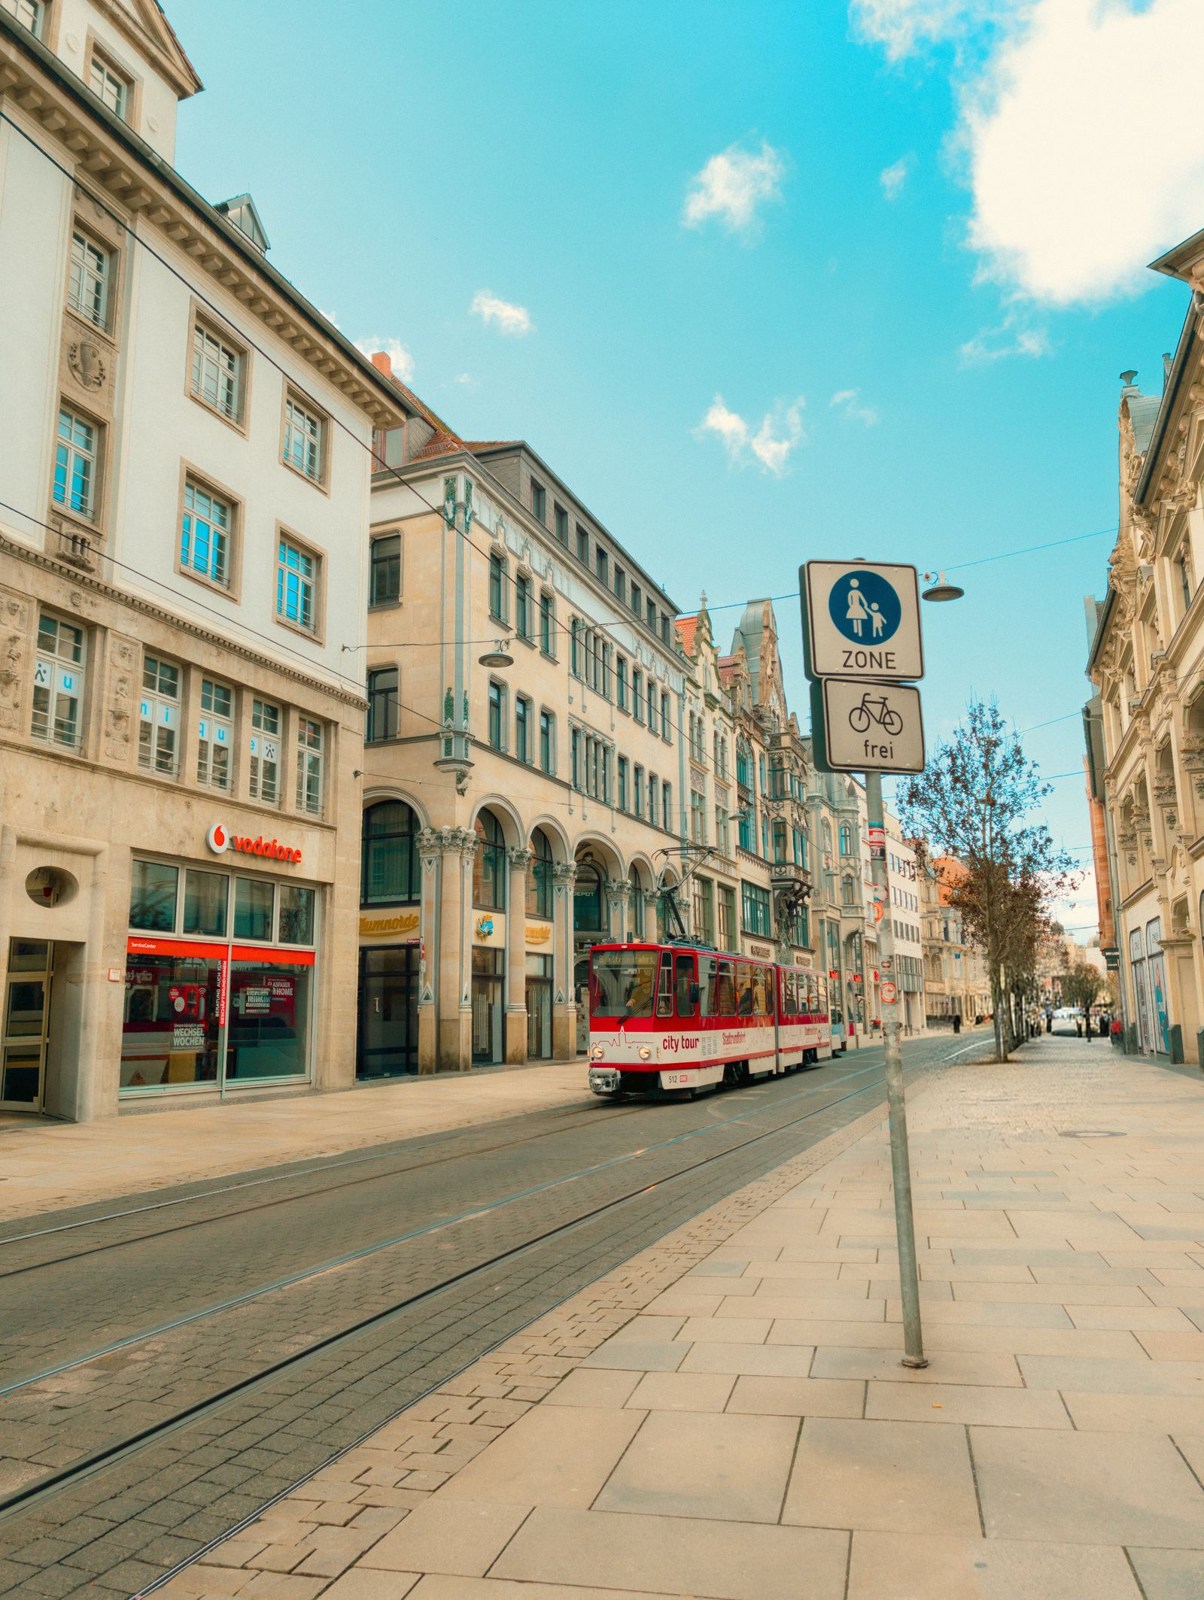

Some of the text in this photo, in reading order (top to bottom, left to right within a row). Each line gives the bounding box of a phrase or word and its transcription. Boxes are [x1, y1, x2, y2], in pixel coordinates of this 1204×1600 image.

[842, 650, 897, 670] ZONE
[863, 740, 894, 759] frei
[232, 835, 302, 864] vodafone
[276, 987, 294, 996] HOME
[173, 1027, 205, 1037] WECHSEL
[173, 1036, 205, 1047] WOCHEN
[662, 1034, 679, 1053] city
[681, 1034, 700, 1049] tour
[668, 1075, 678, 1084] 512
